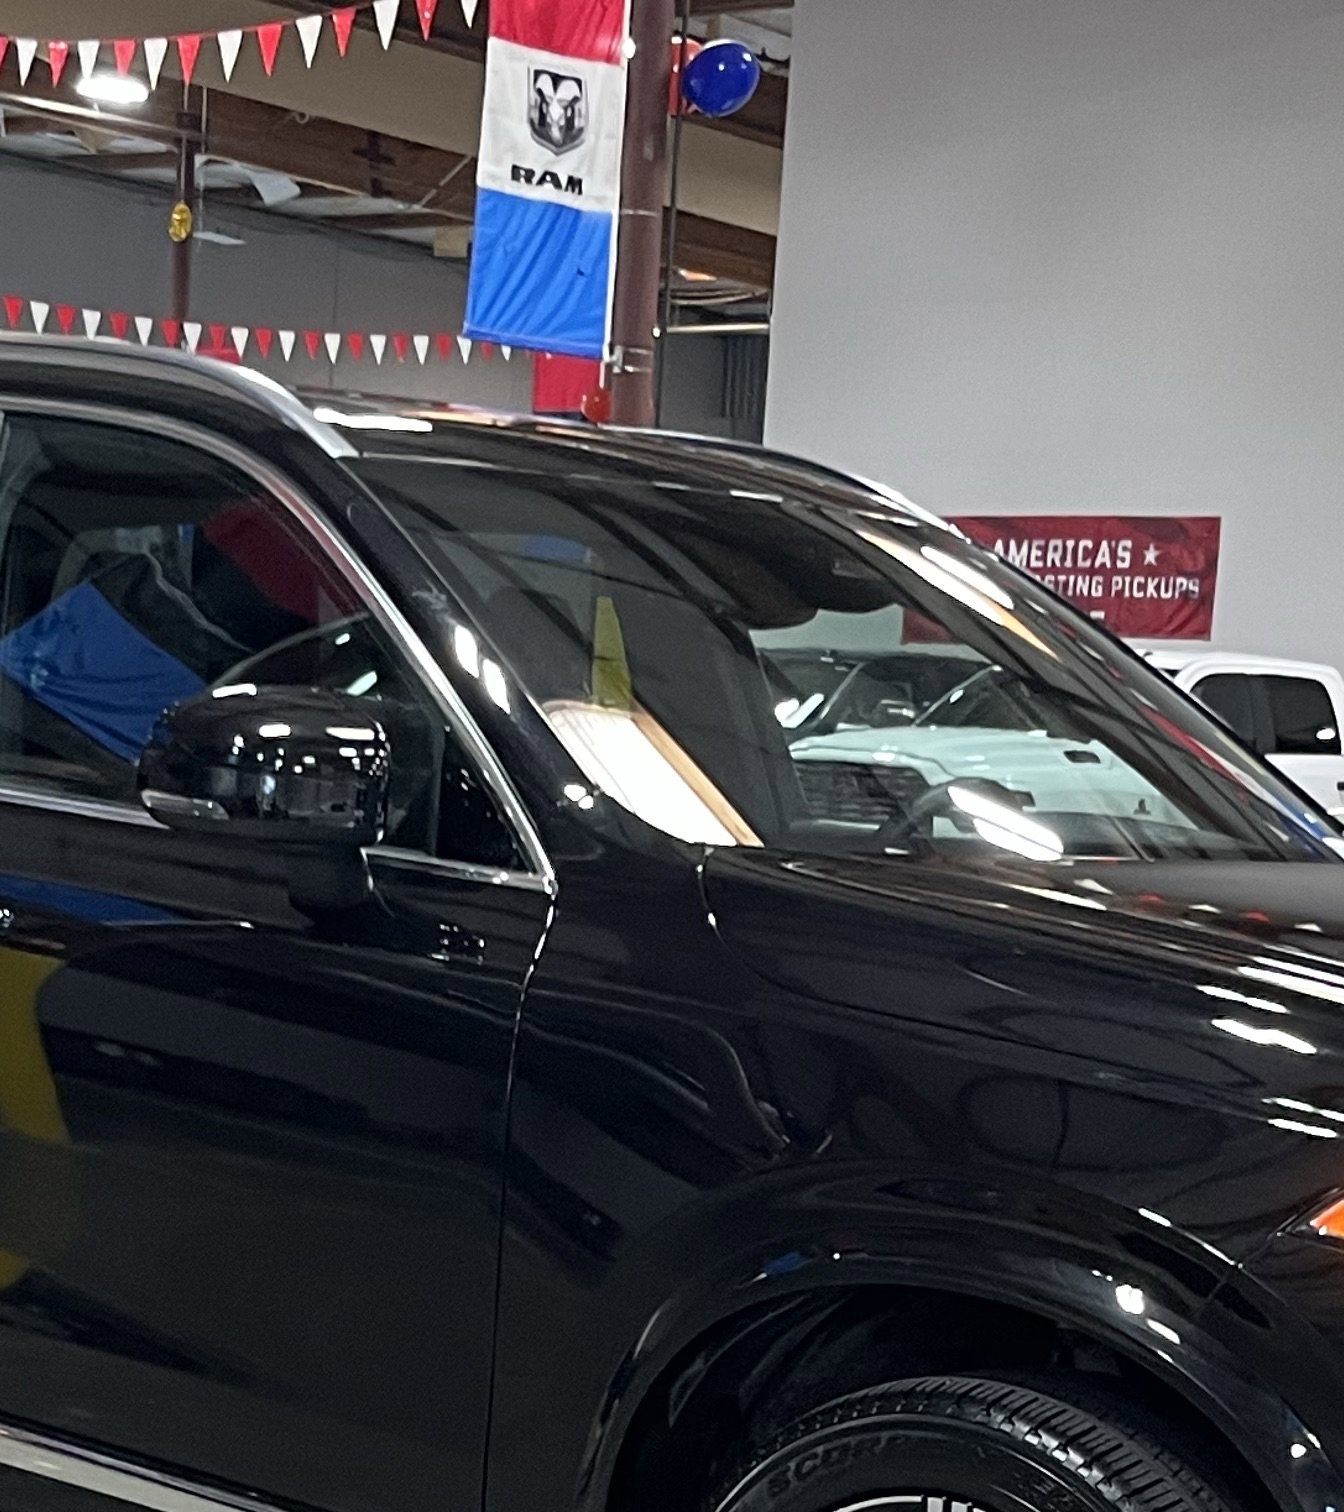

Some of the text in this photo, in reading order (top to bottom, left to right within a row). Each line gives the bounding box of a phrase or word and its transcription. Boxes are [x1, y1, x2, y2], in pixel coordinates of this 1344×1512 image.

[510, 163, 584, 196] RAM
[994, 538, 1132, 569] AMERICA'S
[1111, 575, 1200, 599] PICKUPS
